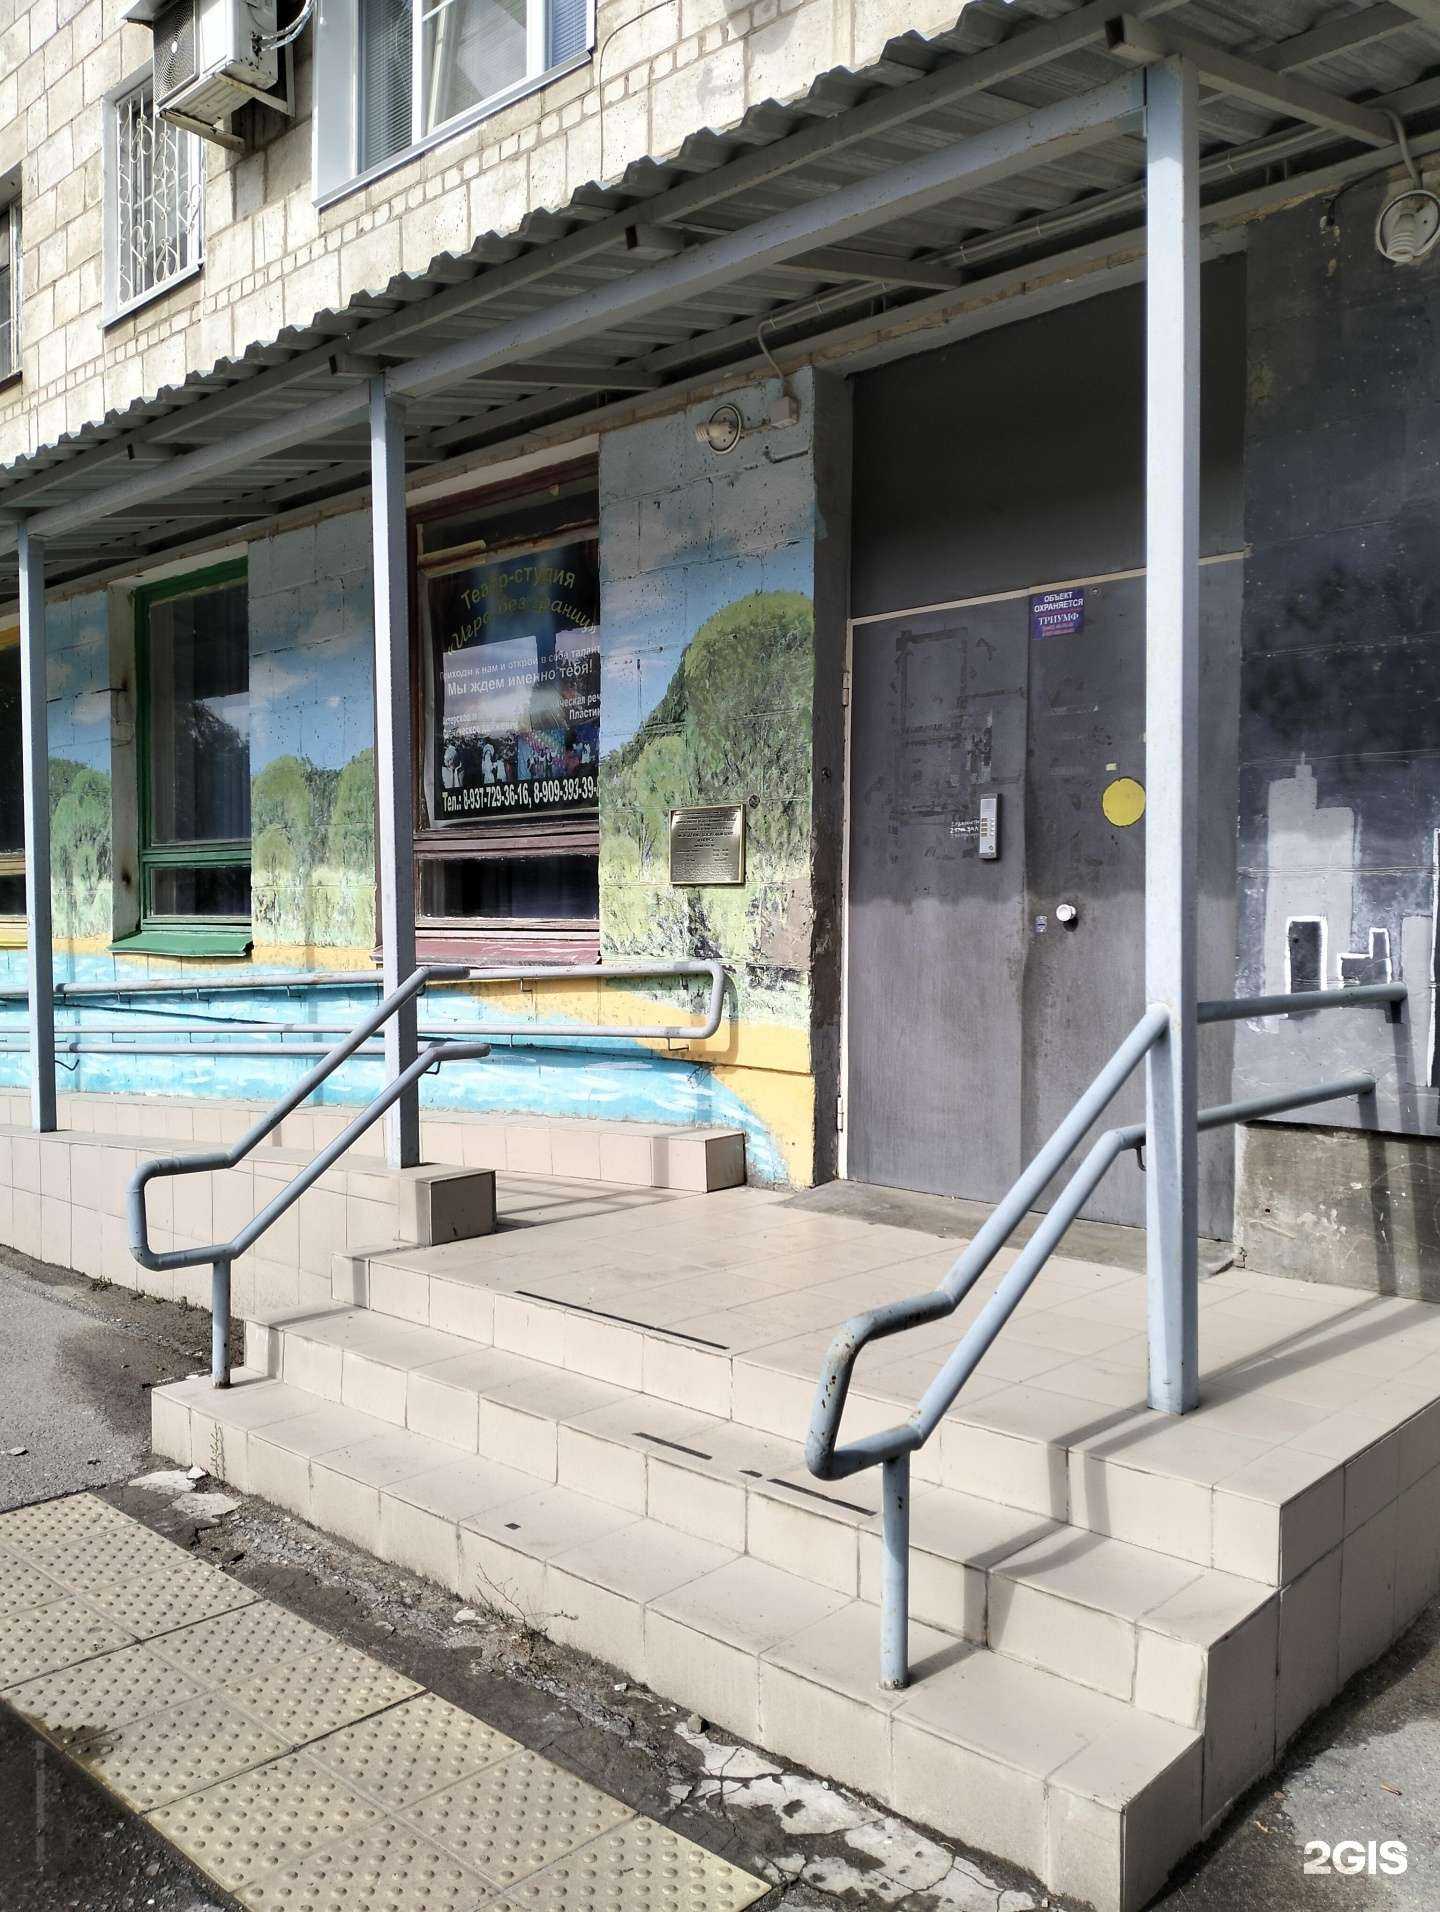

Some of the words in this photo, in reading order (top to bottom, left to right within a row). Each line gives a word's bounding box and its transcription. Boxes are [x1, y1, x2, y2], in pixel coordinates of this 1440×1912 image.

[1044, 592, 1073, 602] ОБЪЕКТ
[1034, 598, 1084, 613] ОХРАНЯЕТСЯ
[1039, 612, 1079, 626] ТРИУМФ
[481, 663, 498, 673] нам
[447, 682, 467, 696] Мы
[470, 678, 504, 694] ждем
[508, 669, 555, 687] именно
[560, 658, 593, 678] тебя!
[463, 783, 532, 811] 8-937-729-36-16,
